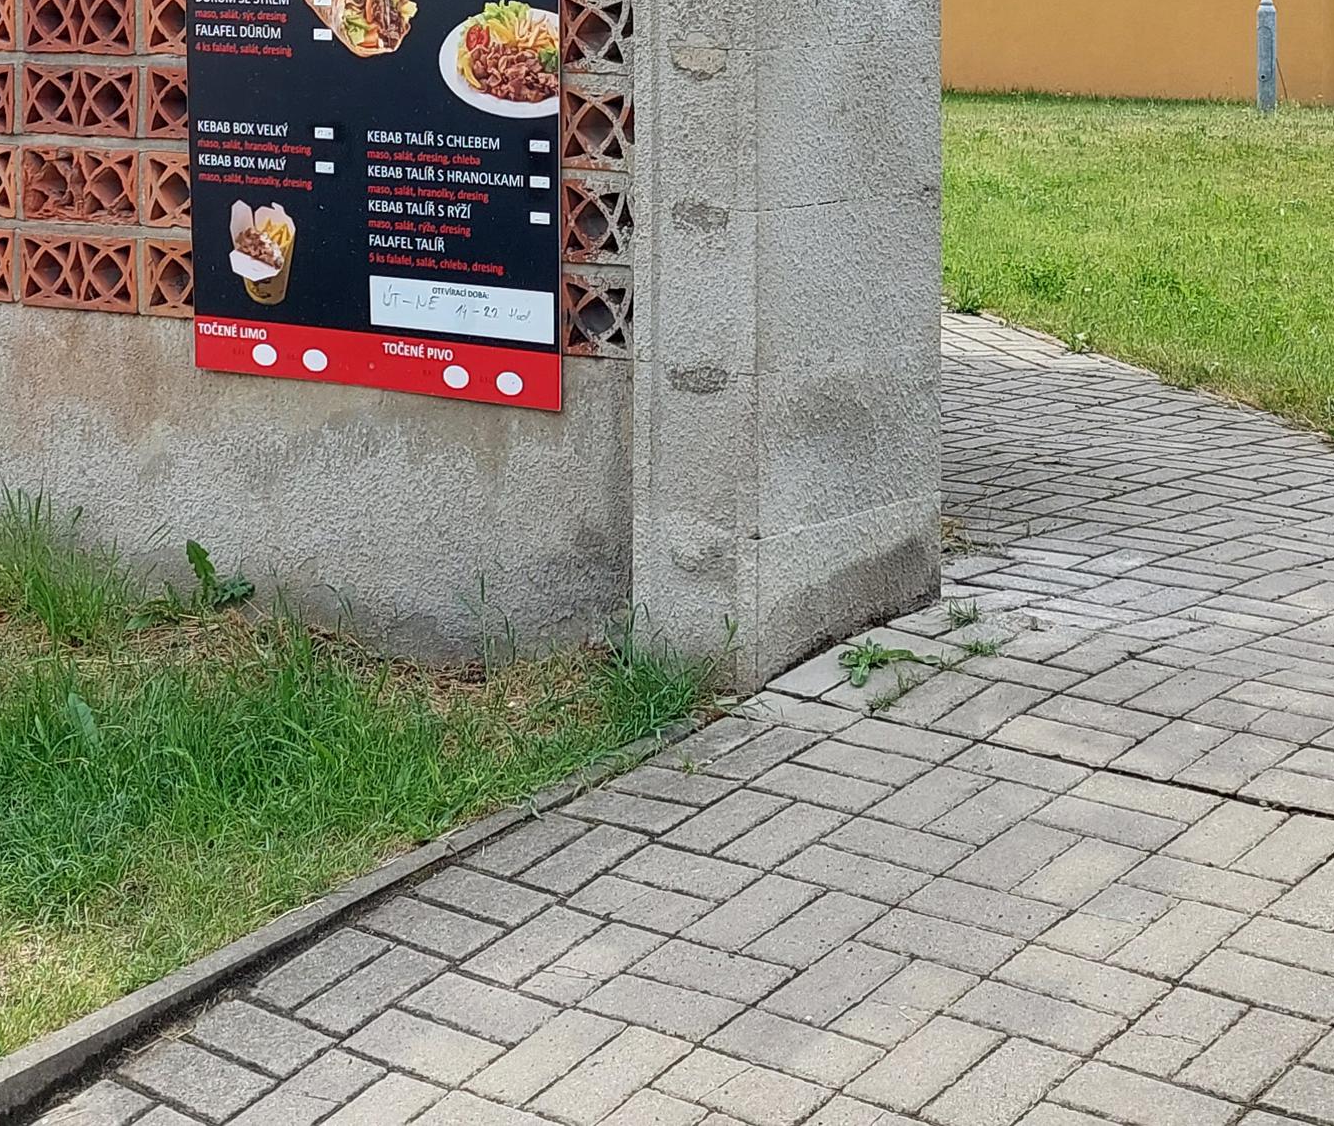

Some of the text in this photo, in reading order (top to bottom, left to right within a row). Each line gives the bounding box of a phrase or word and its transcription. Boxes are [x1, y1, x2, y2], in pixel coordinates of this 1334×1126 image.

[196, 24, 281, 39] FALAFEL DÜRÜM
[197, 120, 288, 137] KEBAB BOX VELKÝ
[367, 130, 500, 150] KEBAB TALÍŘ S CHLEBEM
[198, 154, 287, 171] KEBAB BOX MALÝ
[367, 165, 524, 188] KEBAB TALÍŘ S HRANOLKAMI
[368, 200, 471, 219] KEBAB TALÍŘ S RÝŽÍ
[369, 234, 445, 253] FALAFEL TALÍŘ
[198, 322, 267, 340] TOČENÉ LIMO
[382, 341, 453, 361] TOČENÉ PIVO
